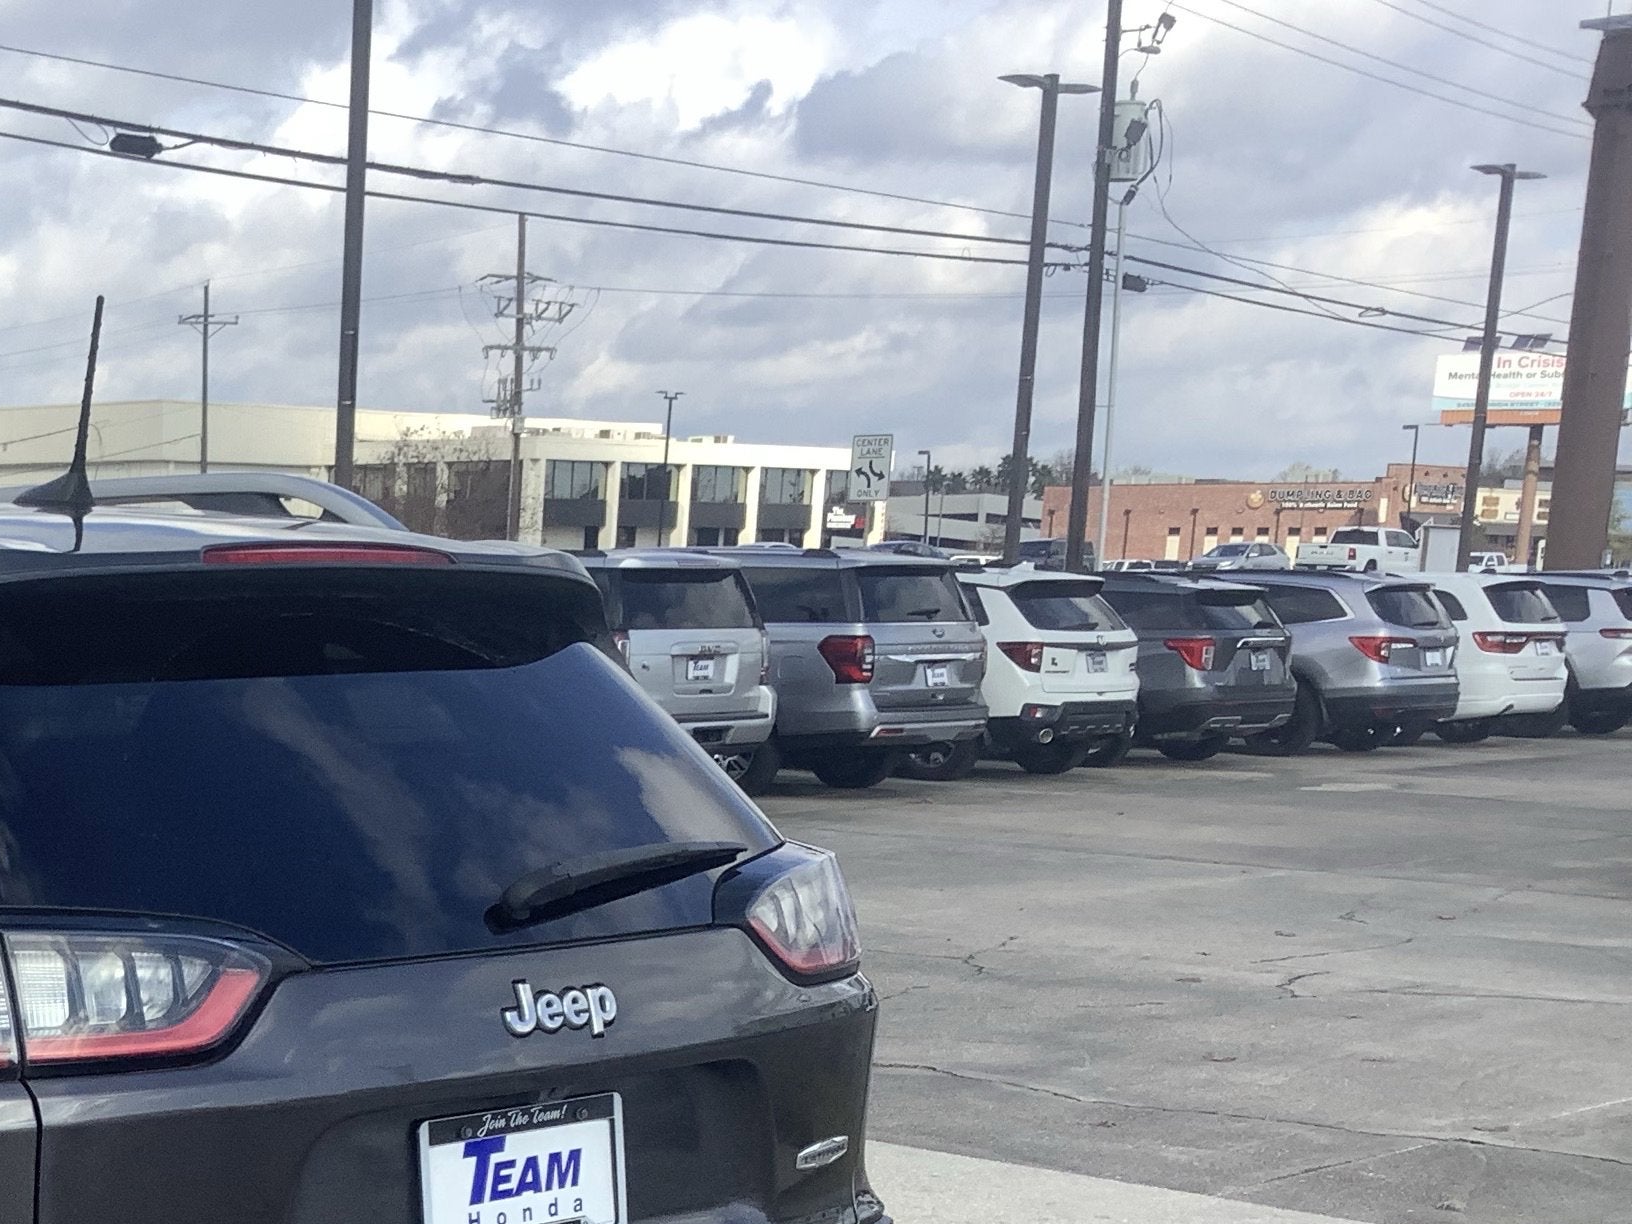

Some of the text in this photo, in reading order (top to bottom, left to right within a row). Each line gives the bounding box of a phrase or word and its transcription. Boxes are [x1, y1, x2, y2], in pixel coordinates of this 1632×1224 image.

[1496, 356, 1567, 368] In Crisis
[1448, 371, 1480, 380] Menta
[856, 438, 889, 447] CENTER
[860, 448, 883, 456] LANE
[857, 489, 880, 498] ONLY
[500, 978, 618, 1039] Jeep
[477, 1104, 567, 1137] Join The Team!
[462, 1135, 583, 1206] TEAM
